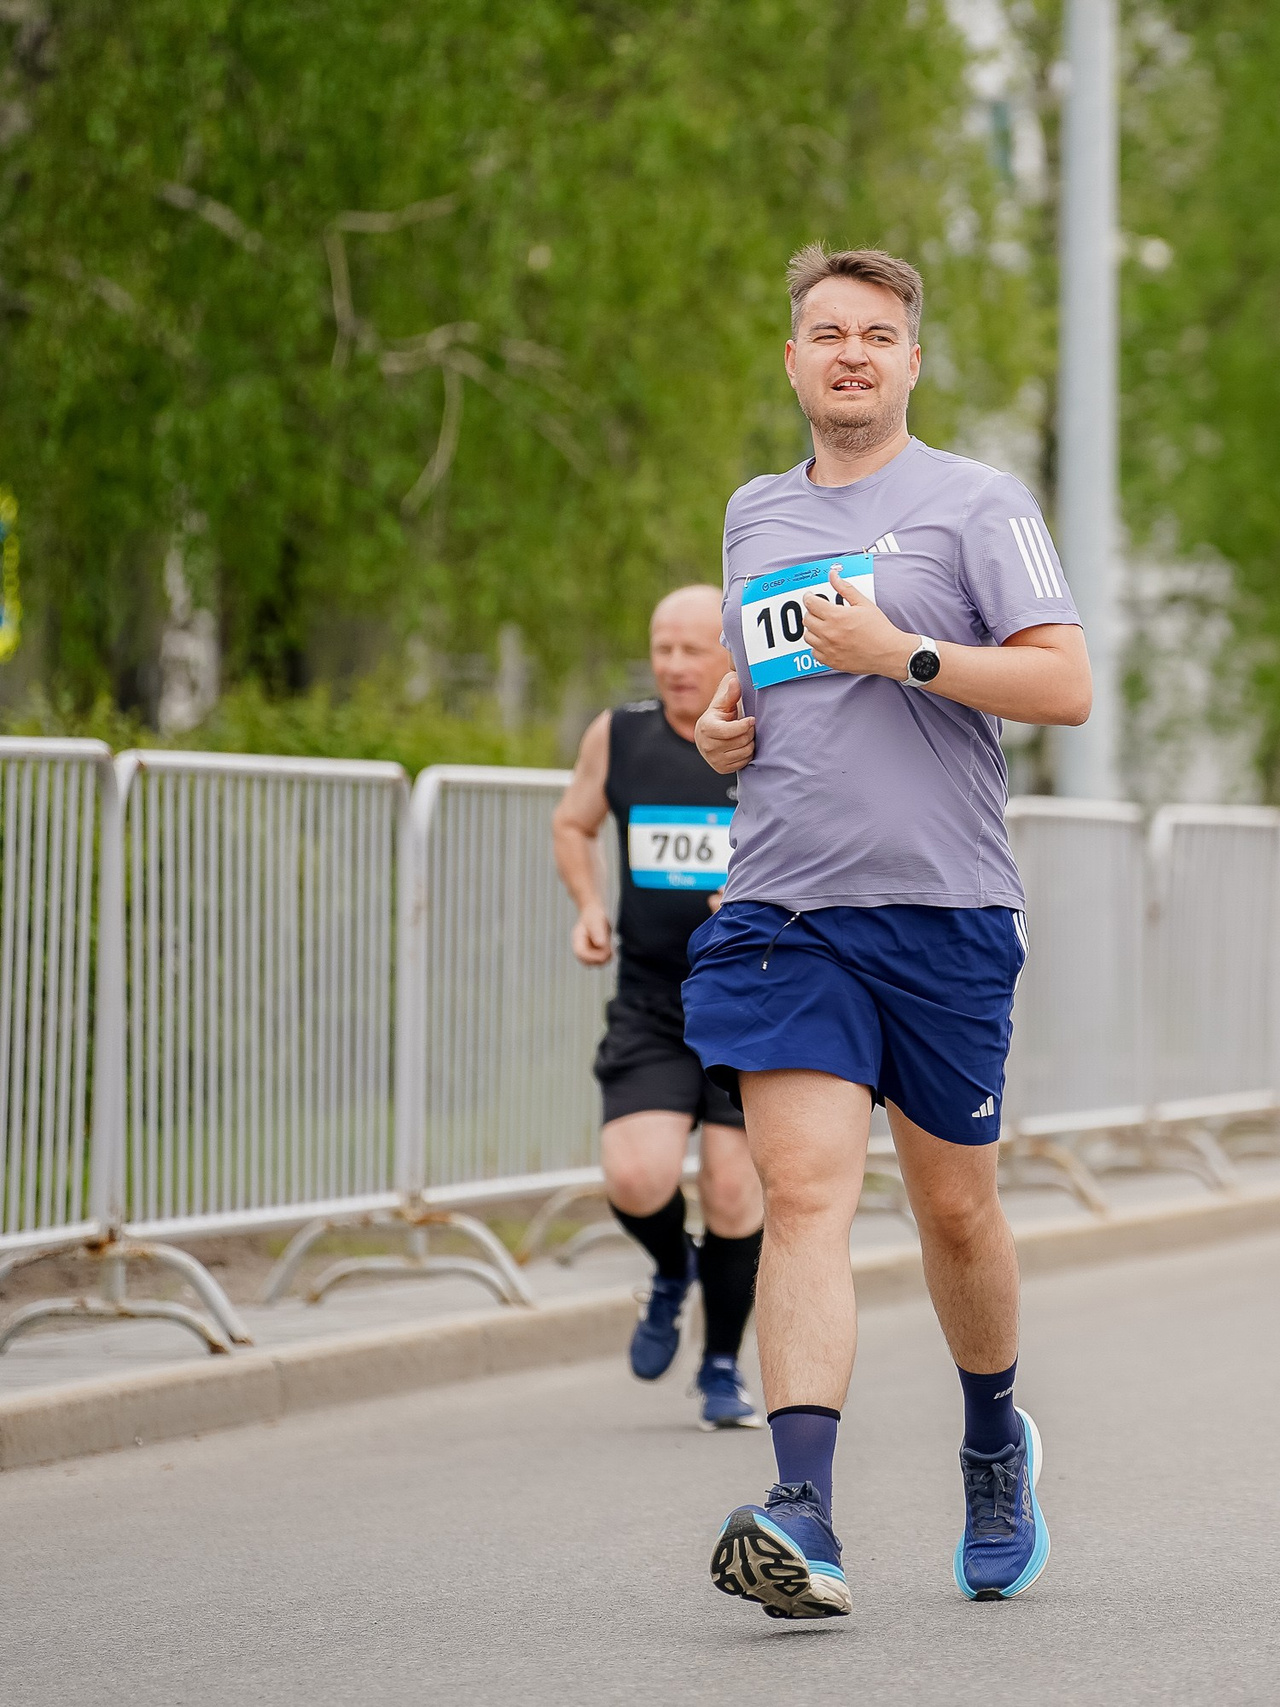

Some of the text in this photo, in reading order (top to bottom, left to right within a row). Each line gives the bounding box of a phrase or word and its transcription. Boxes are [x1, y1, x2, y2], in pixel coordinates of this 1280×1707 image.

[757, 594, 845, 649] 10
[652, 833, 714, 862] 706
[1022, 1464, 1034, 1525] HOKA
